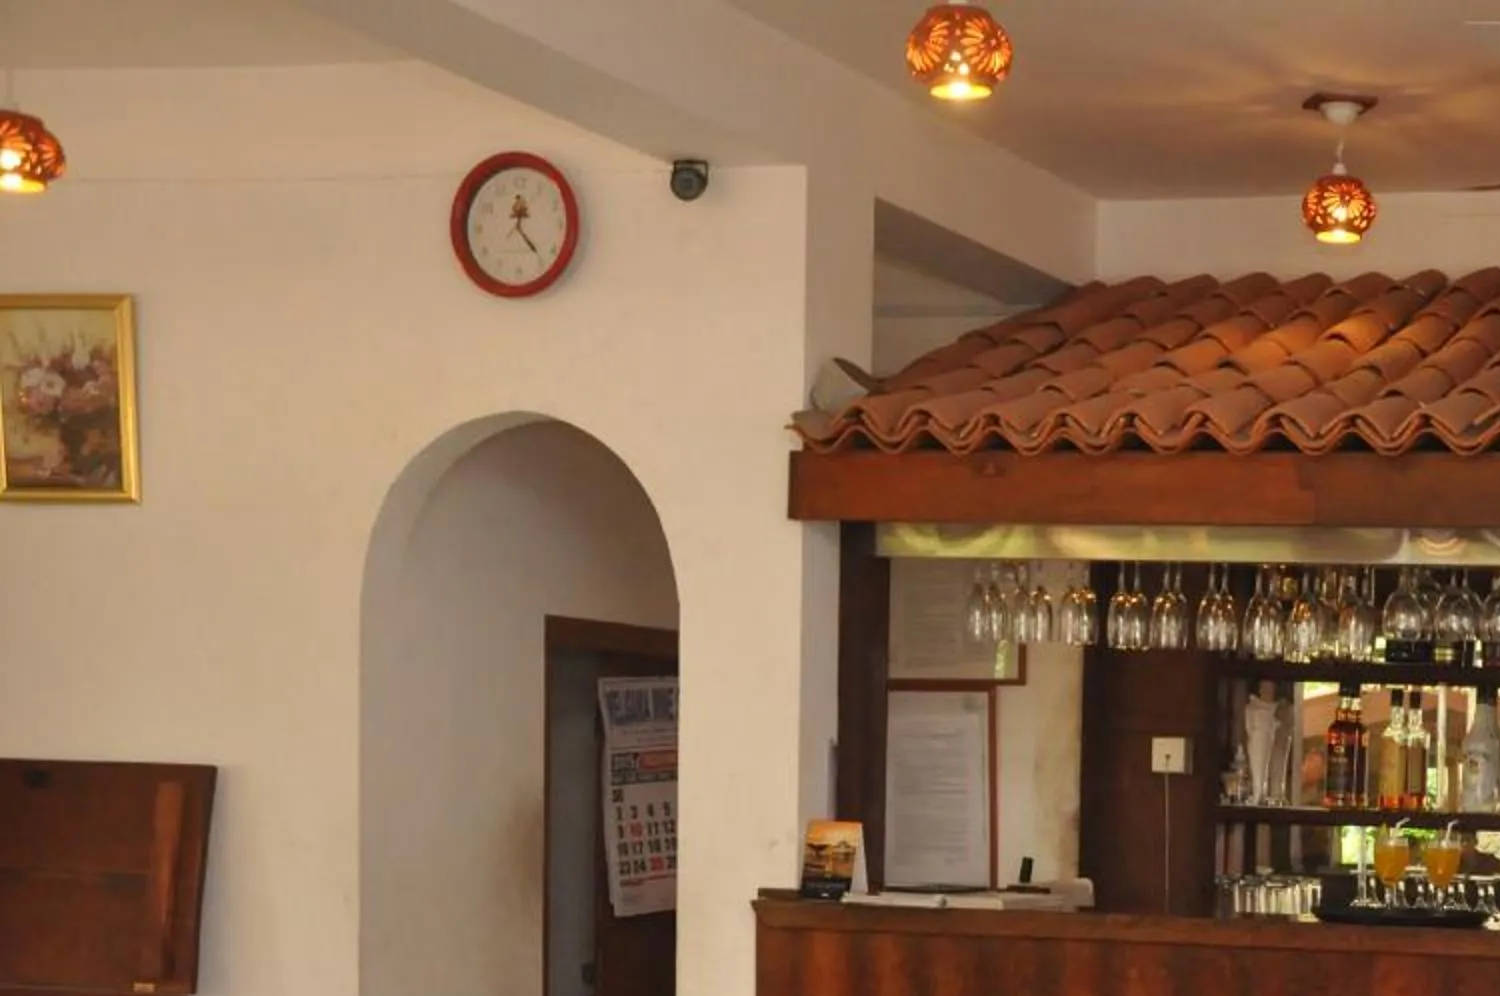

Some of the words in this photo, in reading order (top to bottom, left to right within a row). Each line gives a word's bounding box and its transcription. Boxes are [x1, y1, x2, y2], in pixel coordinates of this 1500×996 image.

[647, 821, 659, 836] 11
[664, 819, 676, 834] 12
[631, 841, 643, 855] 17
[634, 859, 646, 874] 24
